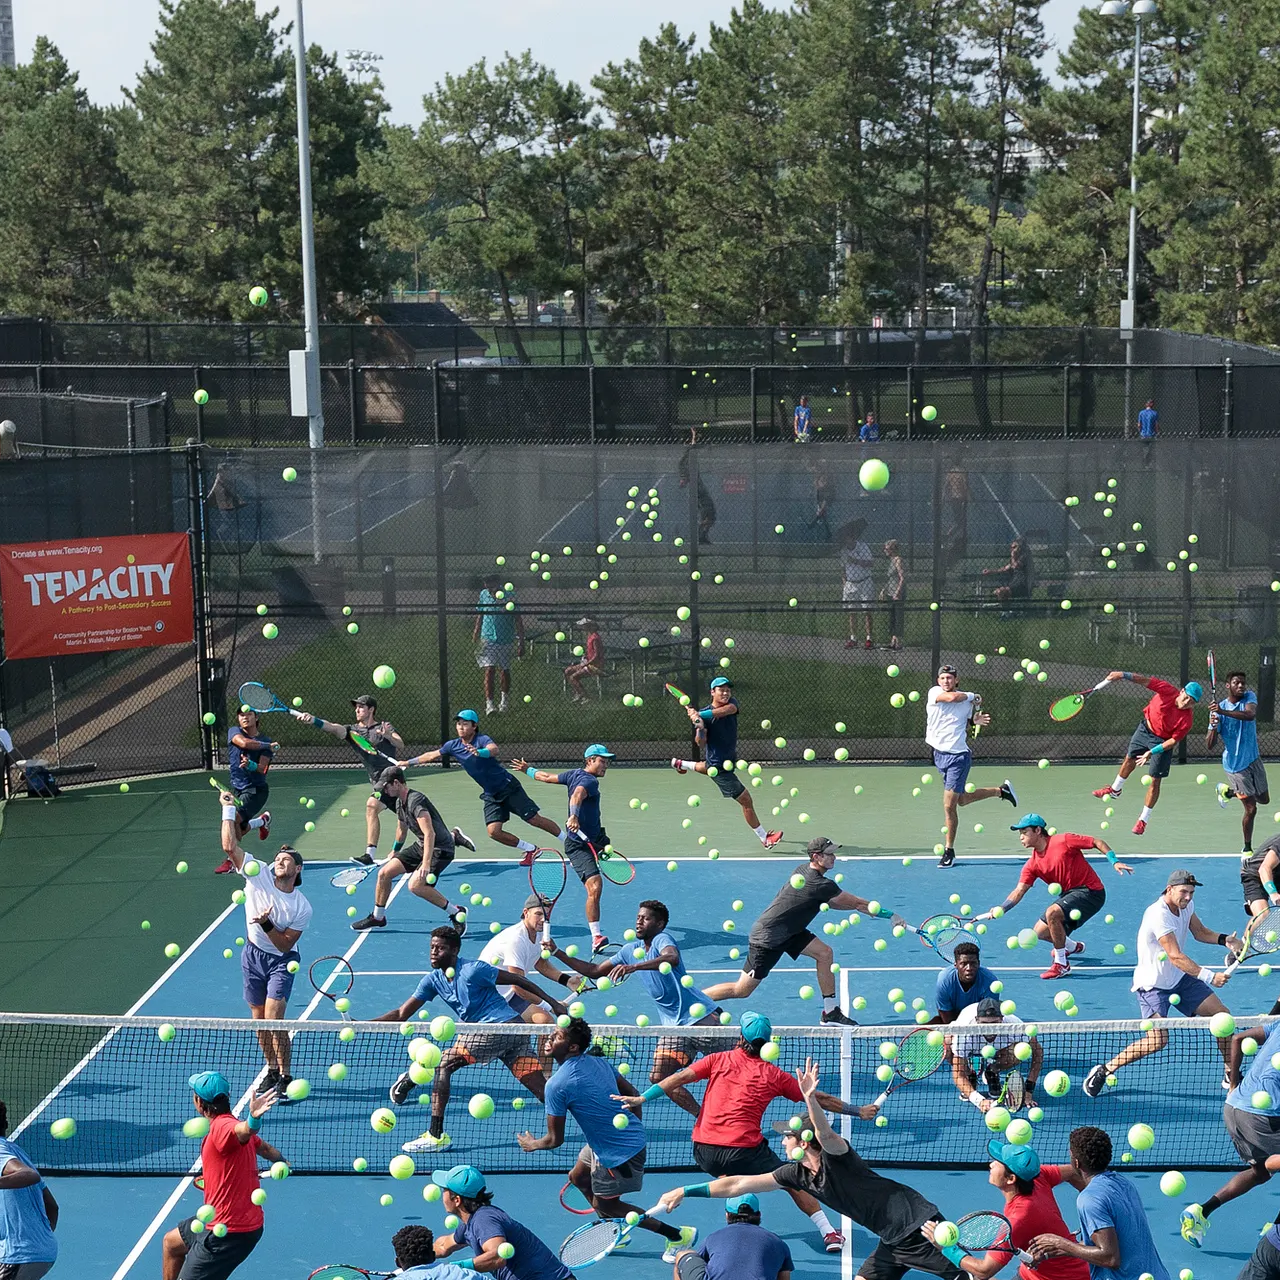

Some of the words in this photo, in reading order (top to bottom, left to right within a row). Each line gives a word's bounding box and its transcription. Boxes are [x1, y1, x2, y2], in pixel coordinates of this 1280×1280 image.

[11, 550, 36, 559] Donate
[45, 545, 103, 556] www.Tenacity.org
[23, 557, 175, 606] TENACITY
[69, 606, 94, 614] Pathway
[104, 602, 150, 611] Post-Secondary
[58, 631, 86, 640] Community
[87, 629, 115, 638] Partnership
